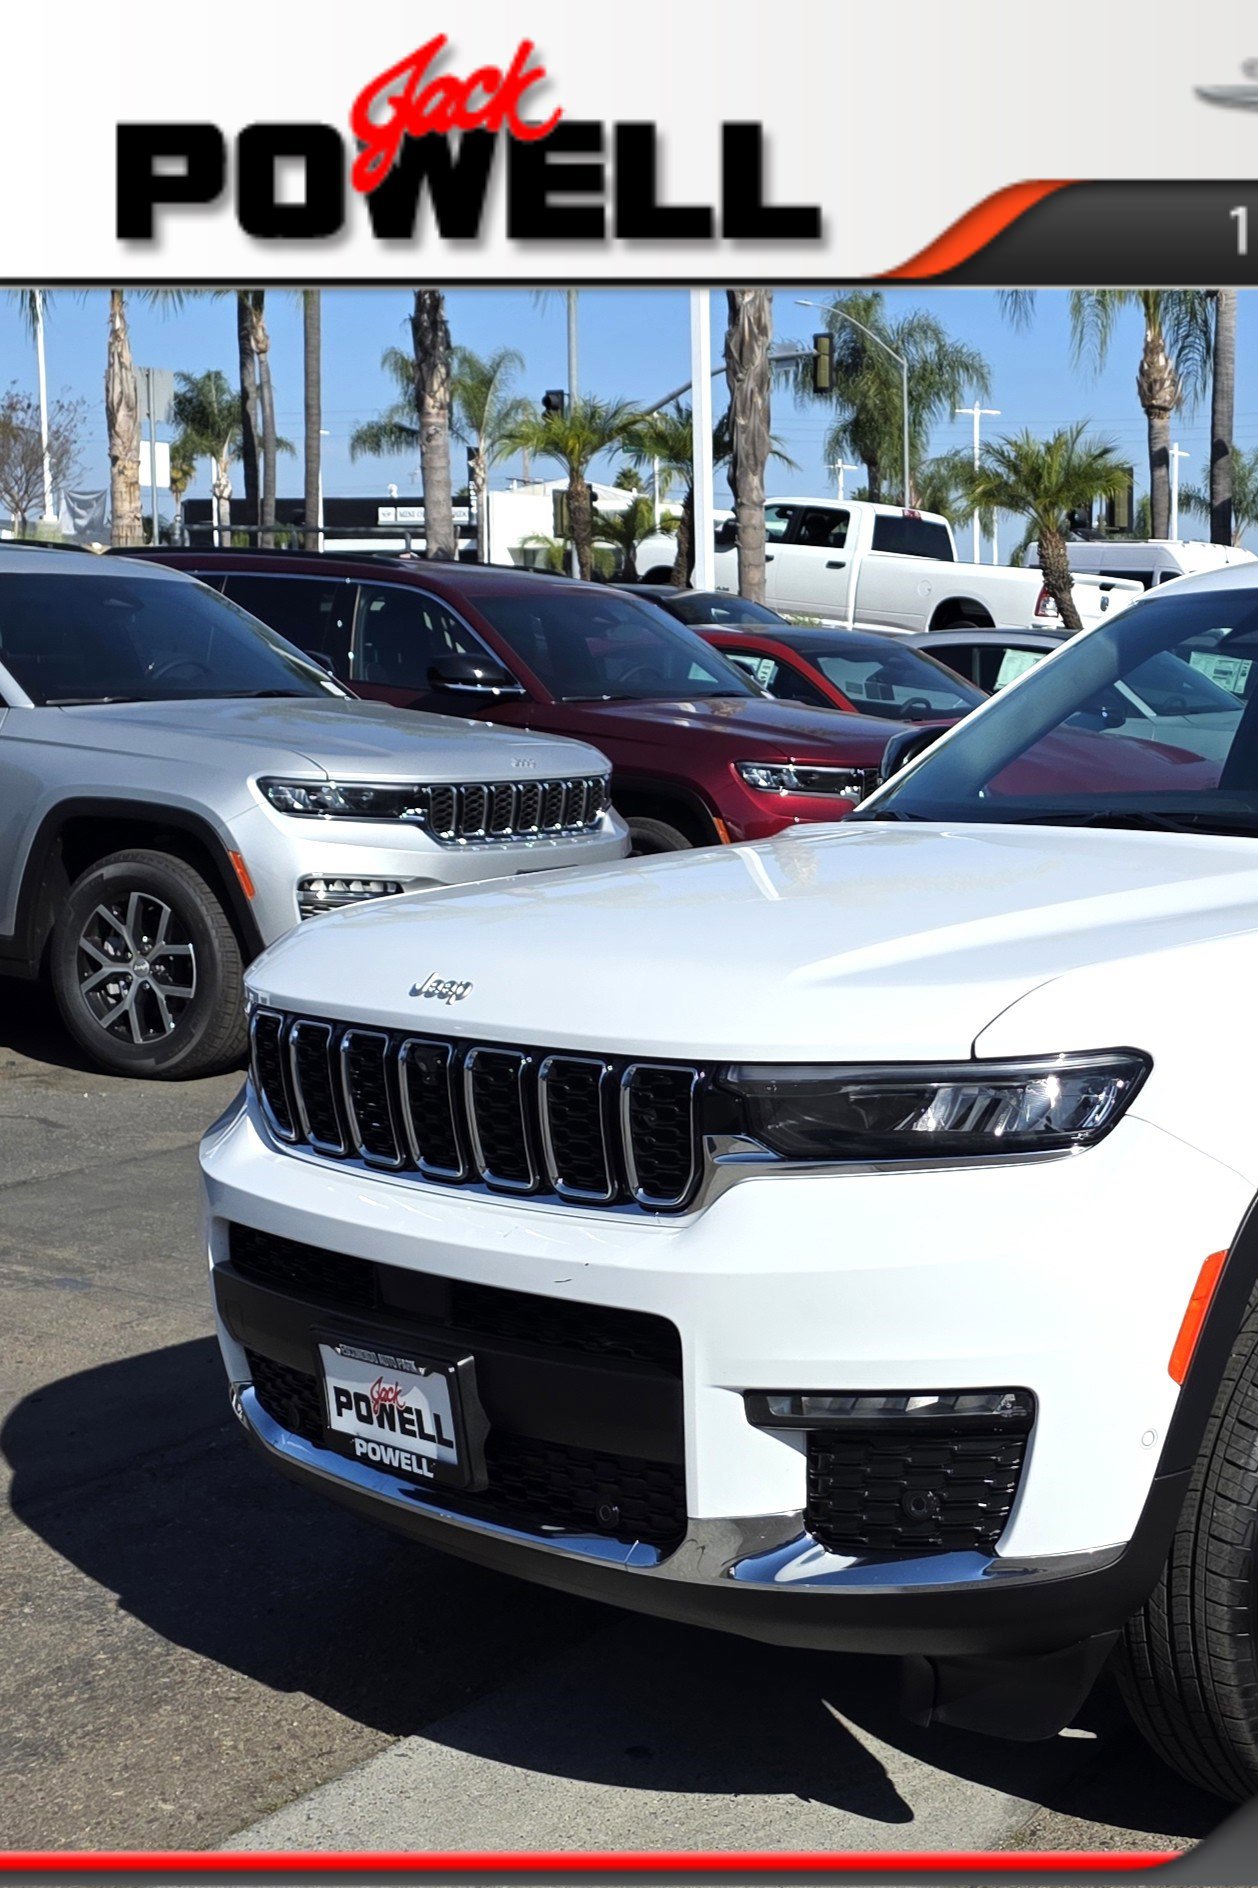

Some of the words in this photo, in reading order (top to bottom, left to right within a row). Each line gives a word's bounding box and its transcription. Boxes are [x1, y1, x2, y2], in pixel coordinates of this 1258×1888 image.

[408, 971, 474, 1006] Jeep
[370, 1376, 407, 1416] Jack
[333, 1386, 455, 1449] POWELL
[354, 1437, 435, 1479] POWELL
